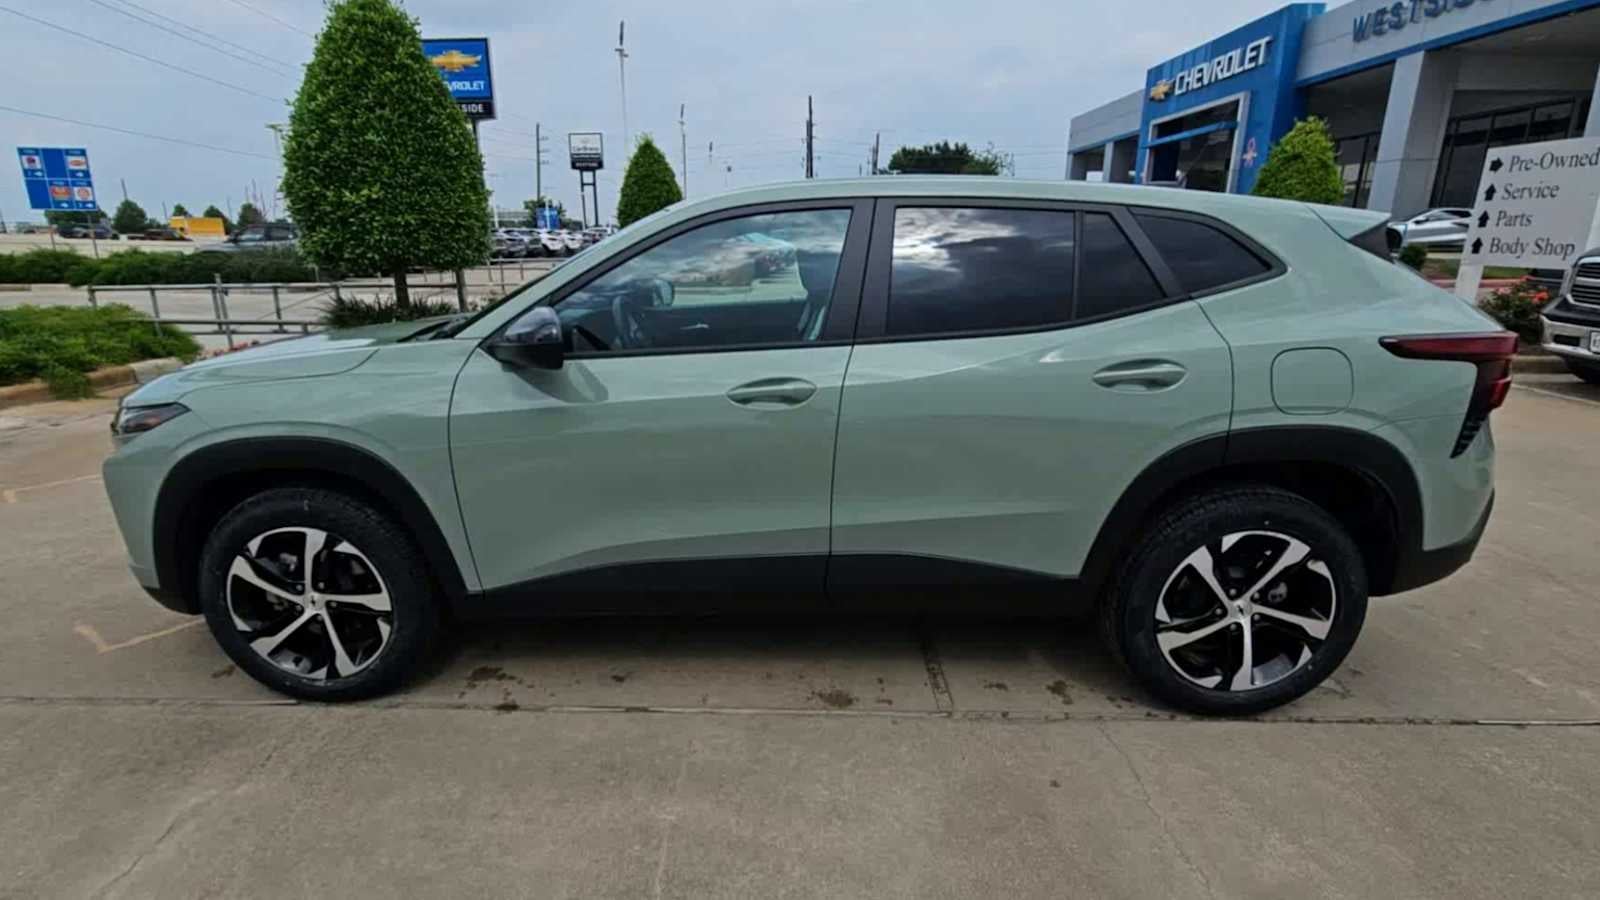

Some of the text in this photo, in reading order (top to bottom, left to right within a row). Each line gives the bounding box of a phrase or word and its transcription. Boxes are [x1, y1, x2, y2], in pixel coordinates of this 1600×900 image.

[1174, 35, 1273, 97] CHEVROLET
[442, 80, 485, 92] VROLET
[460, 103, 485, 113] SIDE
[1509, 147, 1600, 173] Pre-Owned
[1501, 181, 1560, 200] Service
[1495, 210, 1534, 228] Parts
[1489, 237, 1576, 261] Body Shop
